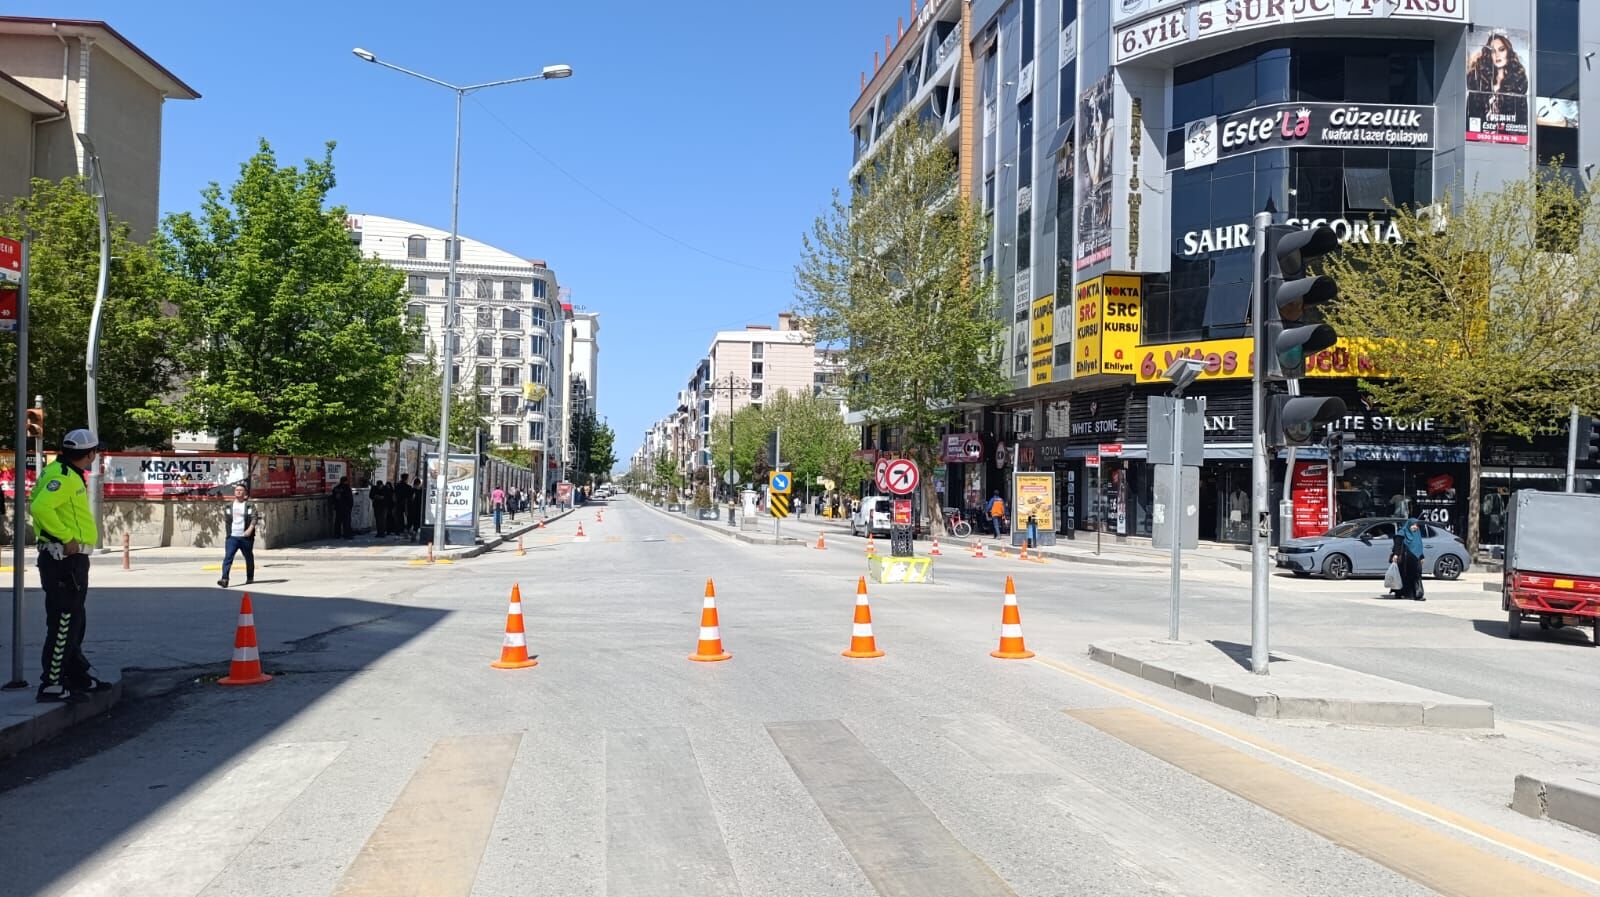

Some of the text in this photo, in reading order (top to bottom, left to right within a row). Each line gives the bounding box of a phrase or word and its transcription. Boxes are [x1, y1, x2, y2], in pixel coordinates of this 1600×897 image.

[1122, 10, 1212, 53] 6.vits
[1330, 107, 1421, 127] Güzellik
[1360, 128, 1385, 141] Lazer
[1183, 223, 1256, 256] SAHR
[1077, 282, 1100, 301] NOKTA
[1105, 286, 1139, 297] NOKTA
[1080, 302, 1097, 322] SRC
[1107, 302, 1138, 317] SRC
[1077, 323, 1099, 339] KURSU
[1104, 322, 1139, 333] KURSU
[1076, 359, 1098, 373] Ehliyet
[1104, 361, 1133, 371] Ehliyet
[1072, 419, 1118, 434] WHITE STONE
[1371, 415, 1435, 432] STONE
[141, 460, 212, 472] KRAKET
